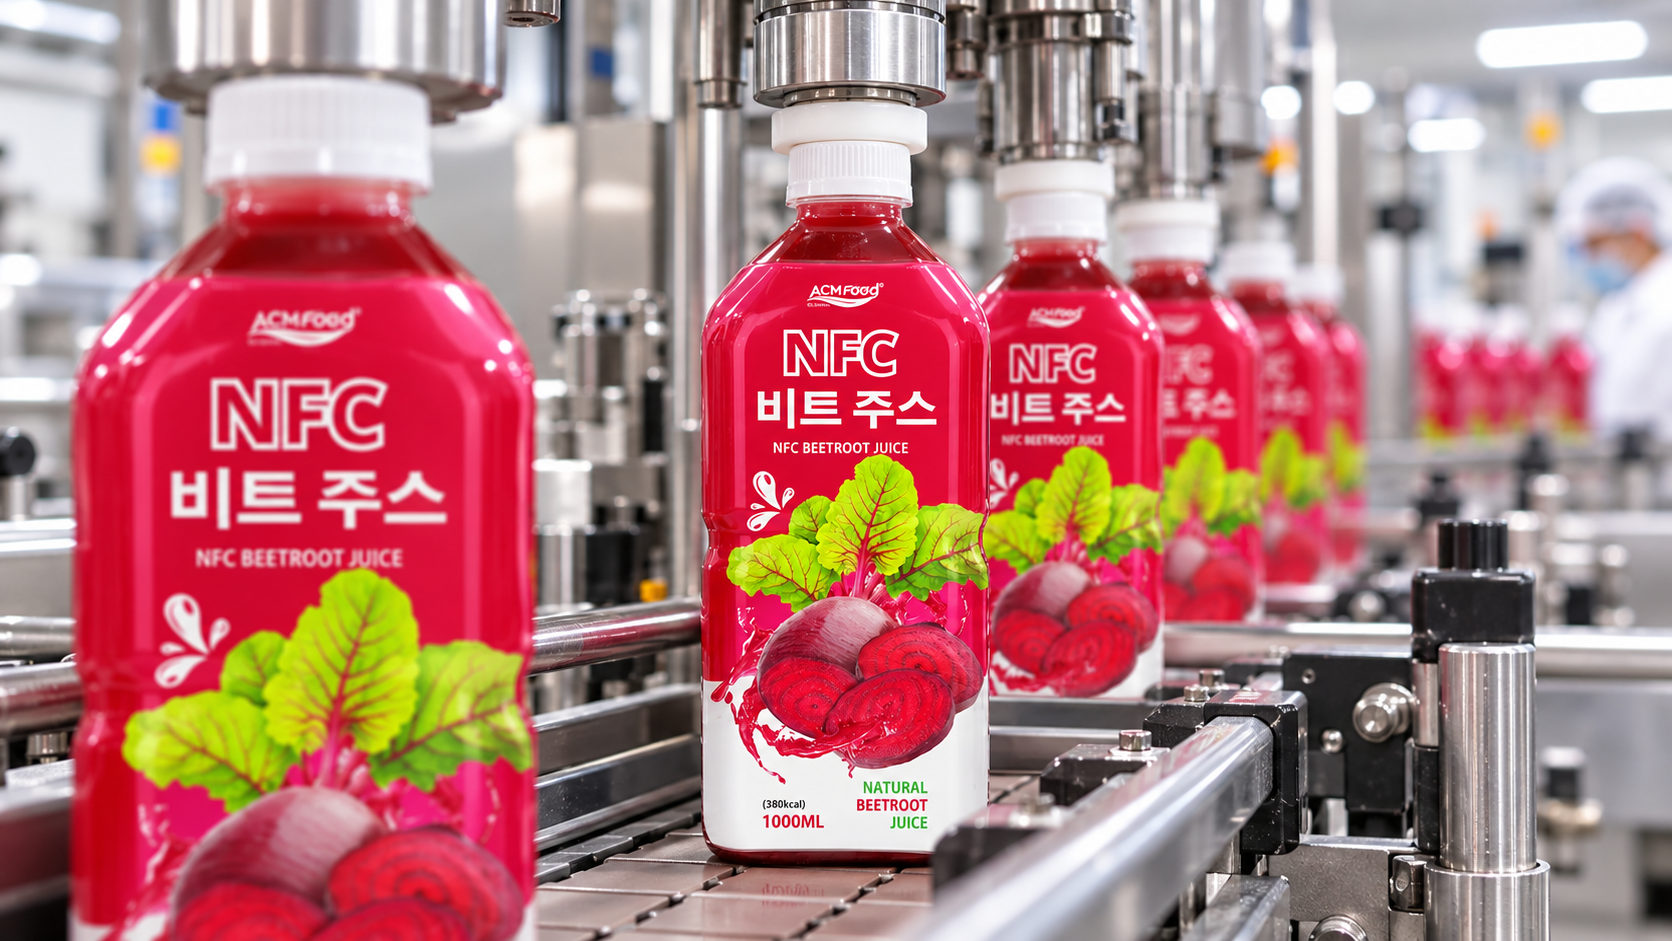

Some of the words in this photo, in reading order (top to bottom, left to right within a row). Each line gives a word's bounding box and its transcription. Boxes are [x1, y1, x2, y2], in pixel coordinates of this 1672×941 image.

[783, 328, 900, 378] NFC
[1009, 342, 1097, 384] NFC
[210, 376, 388, 452] NFC
[757, 388, 842, 429] 비트
[853, 390, 938, 429] 주스
[990, 391, 1055, 426] 비트
[1062, 392, 1127, 426] 주스
[773, 442, 799, 454] NFC
[802, 442, 871, 454] BEETROOT
[873, 442, 909, 455] JUICE
[1001, 434, 1022, 446] NFC
[1024, 434, 1076, 446] BEETROOT
[1077, 434, 1104, 447] JUICE
[170, 467, 302, 530] 비트
[317, 470, 447, 530] 주스
[195, 549, 236, 568] NFC
[241, 549, 345, 568] BEETROOT
[348, 549, 403, 569] JUICE
[863, 781, 928, 794] NATURAL
[762, 799, 806, 810] (380kcal)
[856, 799, 928, 812] BEETROOT
[762, 814, 825, 829] 1000ML
[890, 816, 928, 830] JUICE
